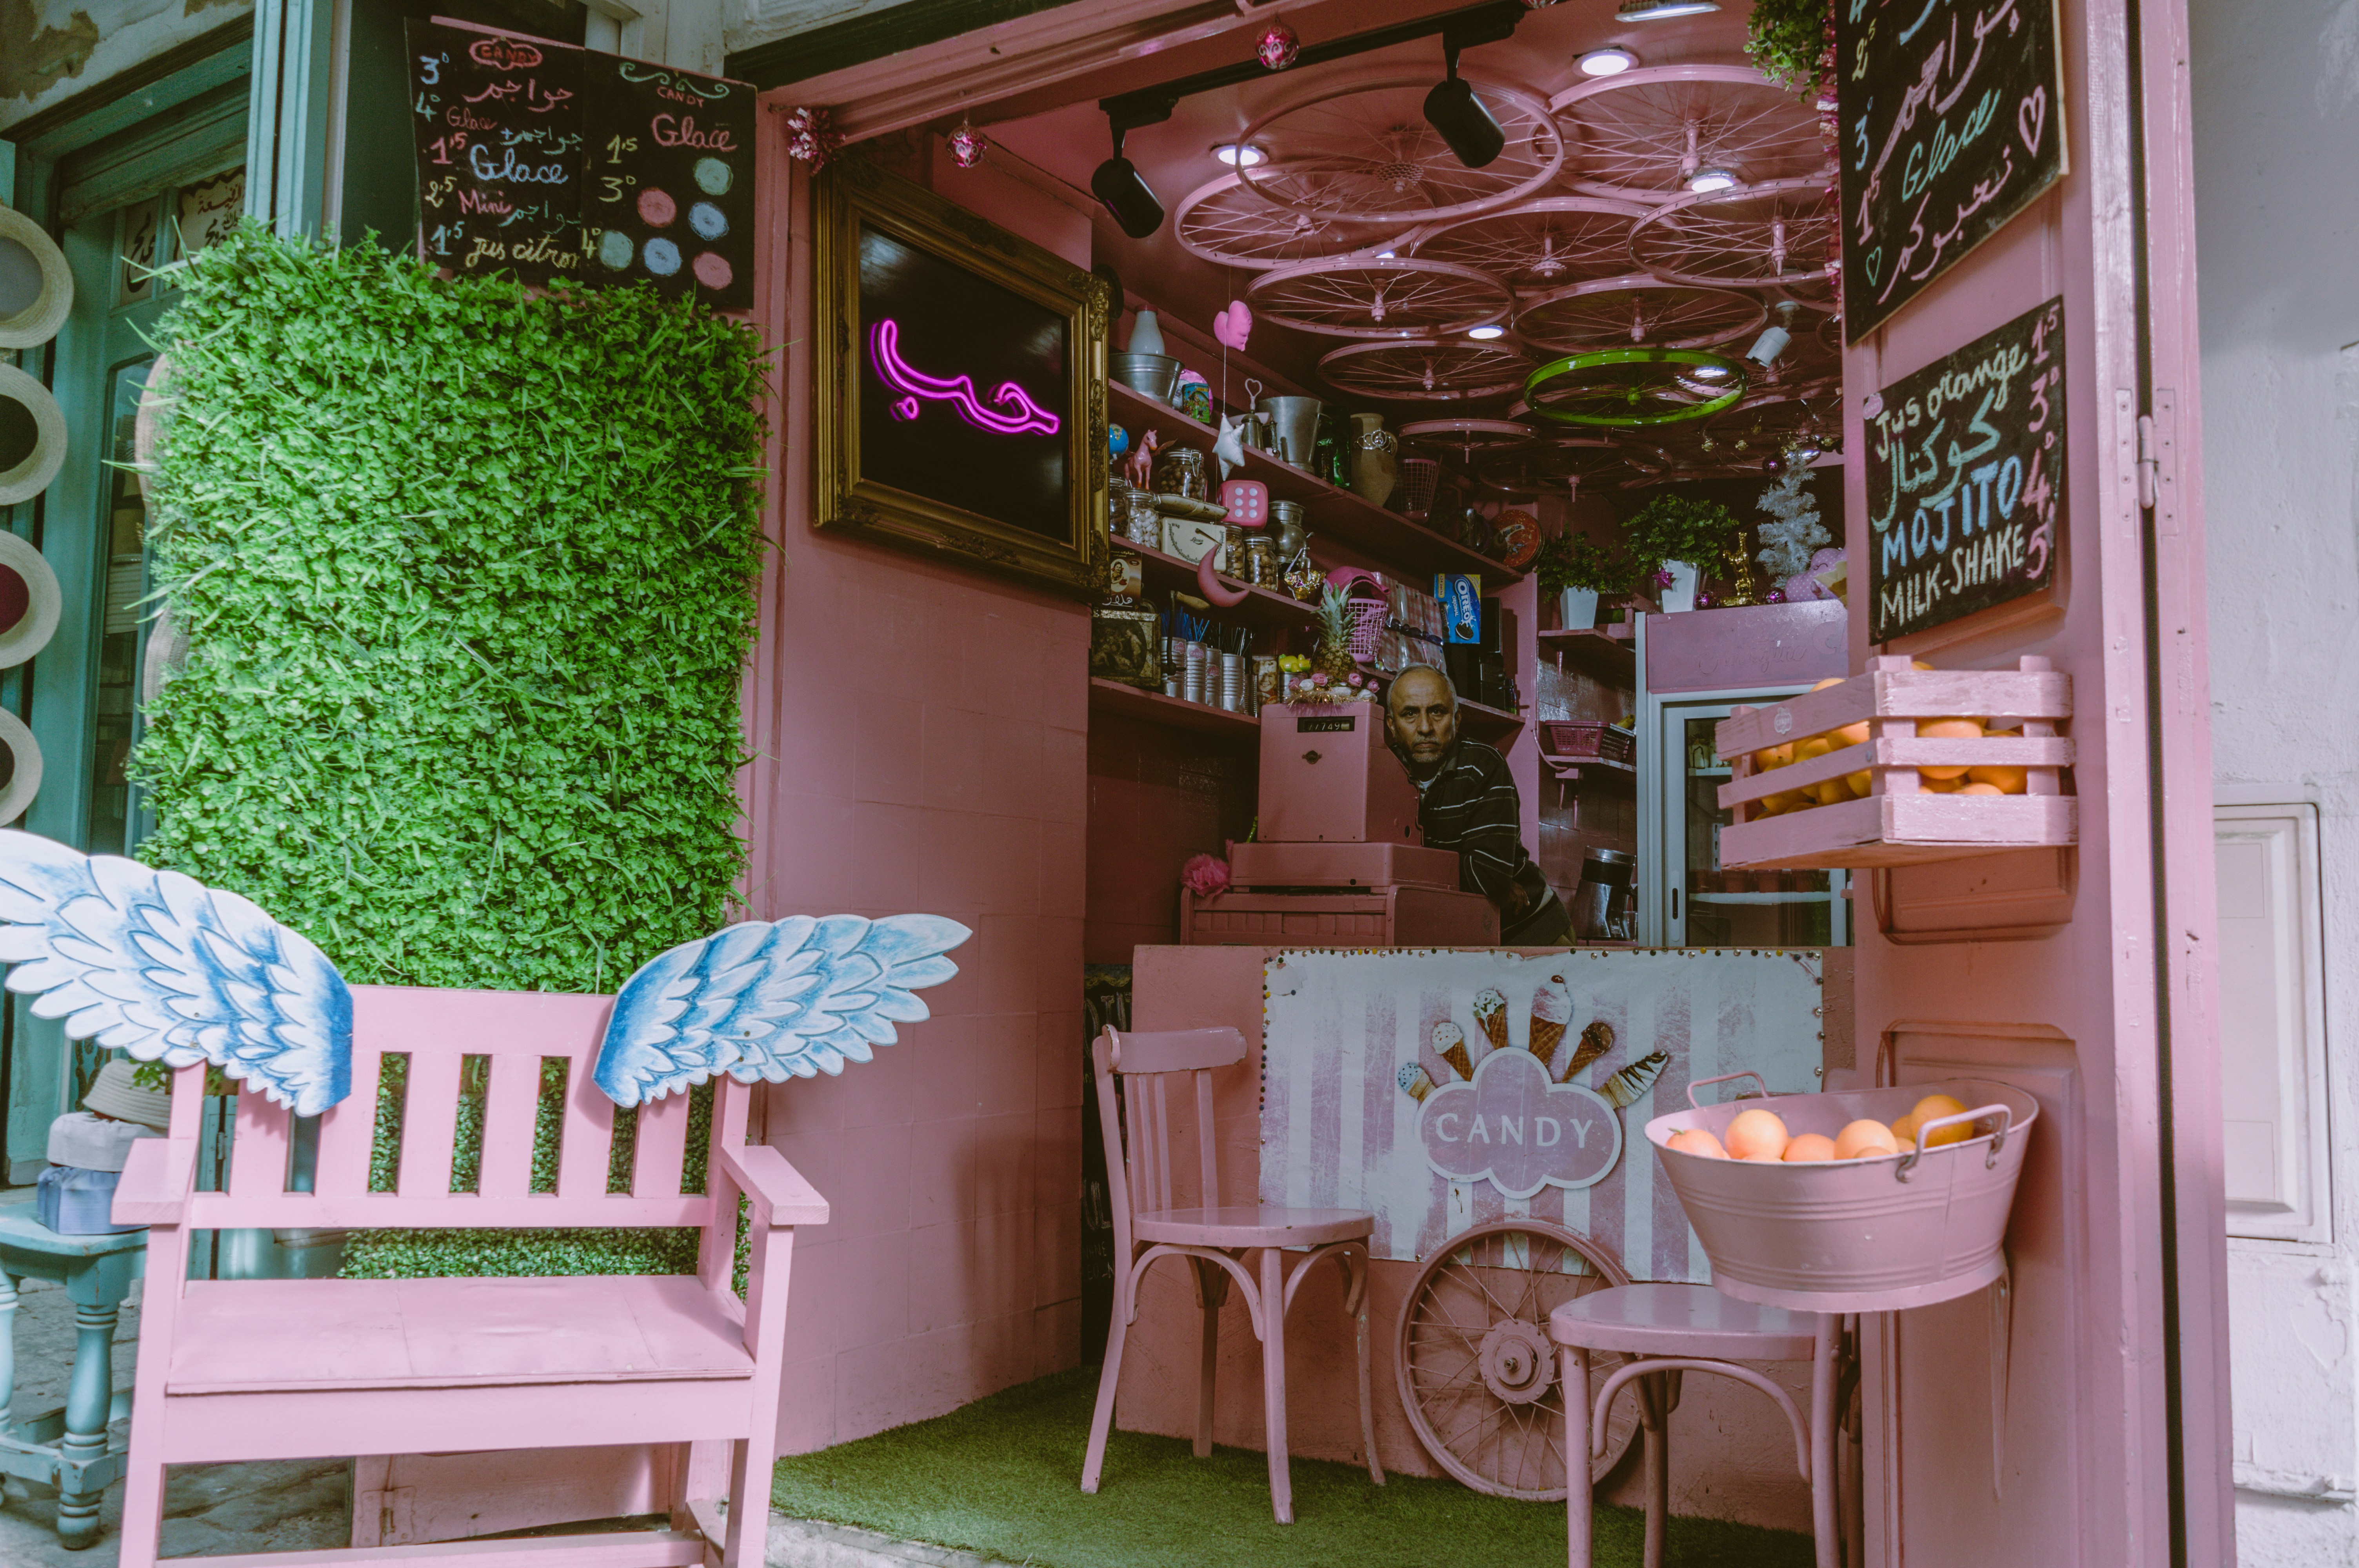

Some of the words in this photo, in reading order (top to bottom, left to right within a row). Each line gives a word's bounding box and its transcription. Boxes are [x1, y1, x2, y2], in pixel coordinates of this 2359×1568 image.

[480, 45, 537, 63] CANDY
[656, 85, 705, 109] CANDY
[650, 112, 738, 153] Glace
[1902, 88, 2001, 203] Glace
[470, 143, 569, 185] Glace
[457, 188, 514, 215] Mini
[1927, 342, 2029, 420] orange
[1882, 455, 2023, 579] MOJITO
[1880, 522, 2025, 632] MILK-SHAKE
[1457, 581, 1470, 621] OREO
[1435, 1112, 1593, 1149] CANDY
